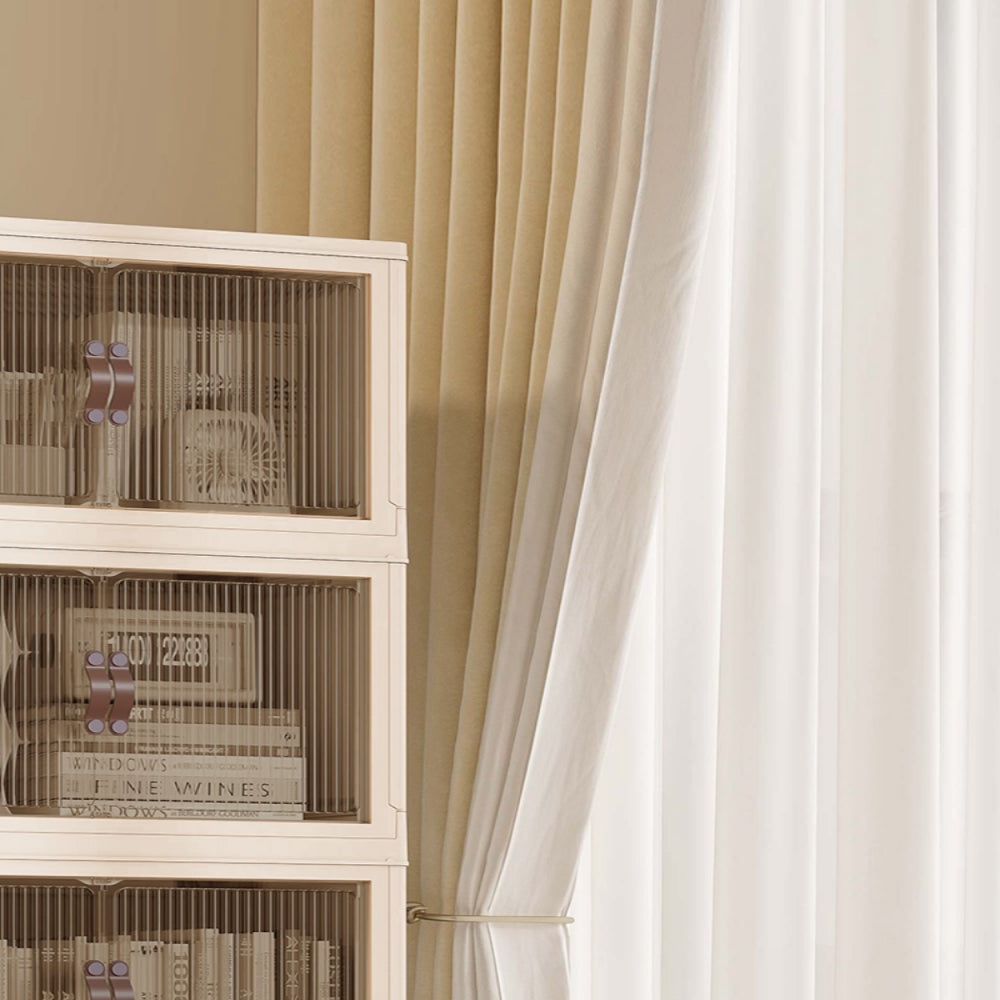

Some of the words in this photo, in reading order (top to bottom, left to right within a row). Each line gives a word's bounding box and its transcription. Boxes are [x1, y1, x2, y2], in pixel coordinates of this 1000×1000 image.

[71, 755, 168, 772] WINDOWS
[94, 779, 158, 795] FINE
[174, 781, 271, 797] WINES
